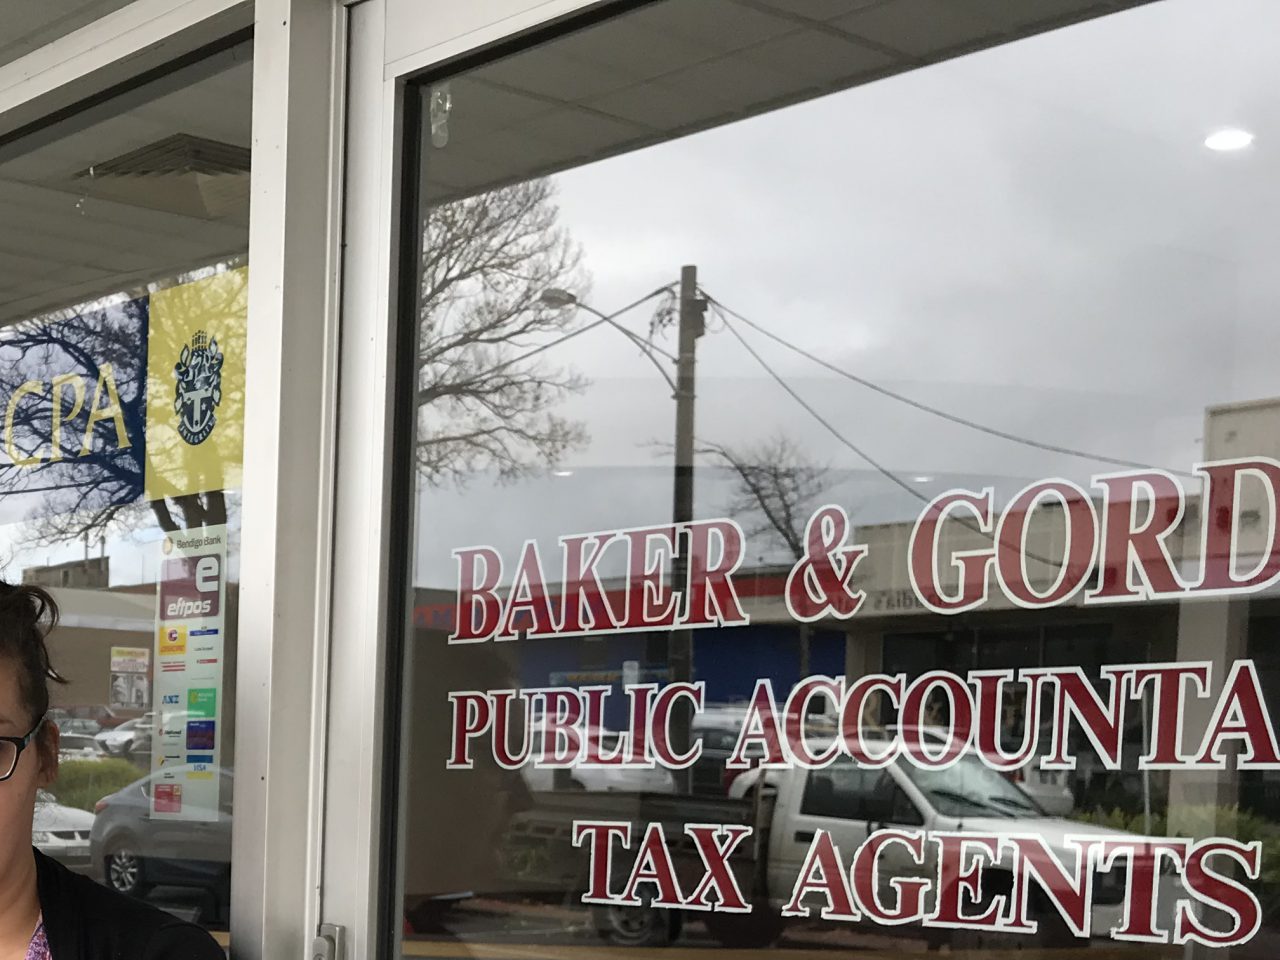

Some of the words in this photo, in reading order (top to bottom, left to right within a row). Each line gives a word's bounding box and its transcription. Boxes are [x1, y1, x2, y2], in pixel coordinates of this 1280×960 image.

[4, 362, 132, 468] CPA
[176, 537, 203, 549] Bendigo
[204, 535, 222, 546] Bank
[447, 517, 750, 644] BAKER
[785, 504, 868, 623] &
[908, 457, 1280, 614] GORD
[167, 597, 212, 617] eftpos
[447, 681, 707, 769] PUBLIC
[727, 660, 1280, 771] ACCOUNTA
[572, 820, 753, 914] TAX
[782, 828, 1262, 947] AGENTS
